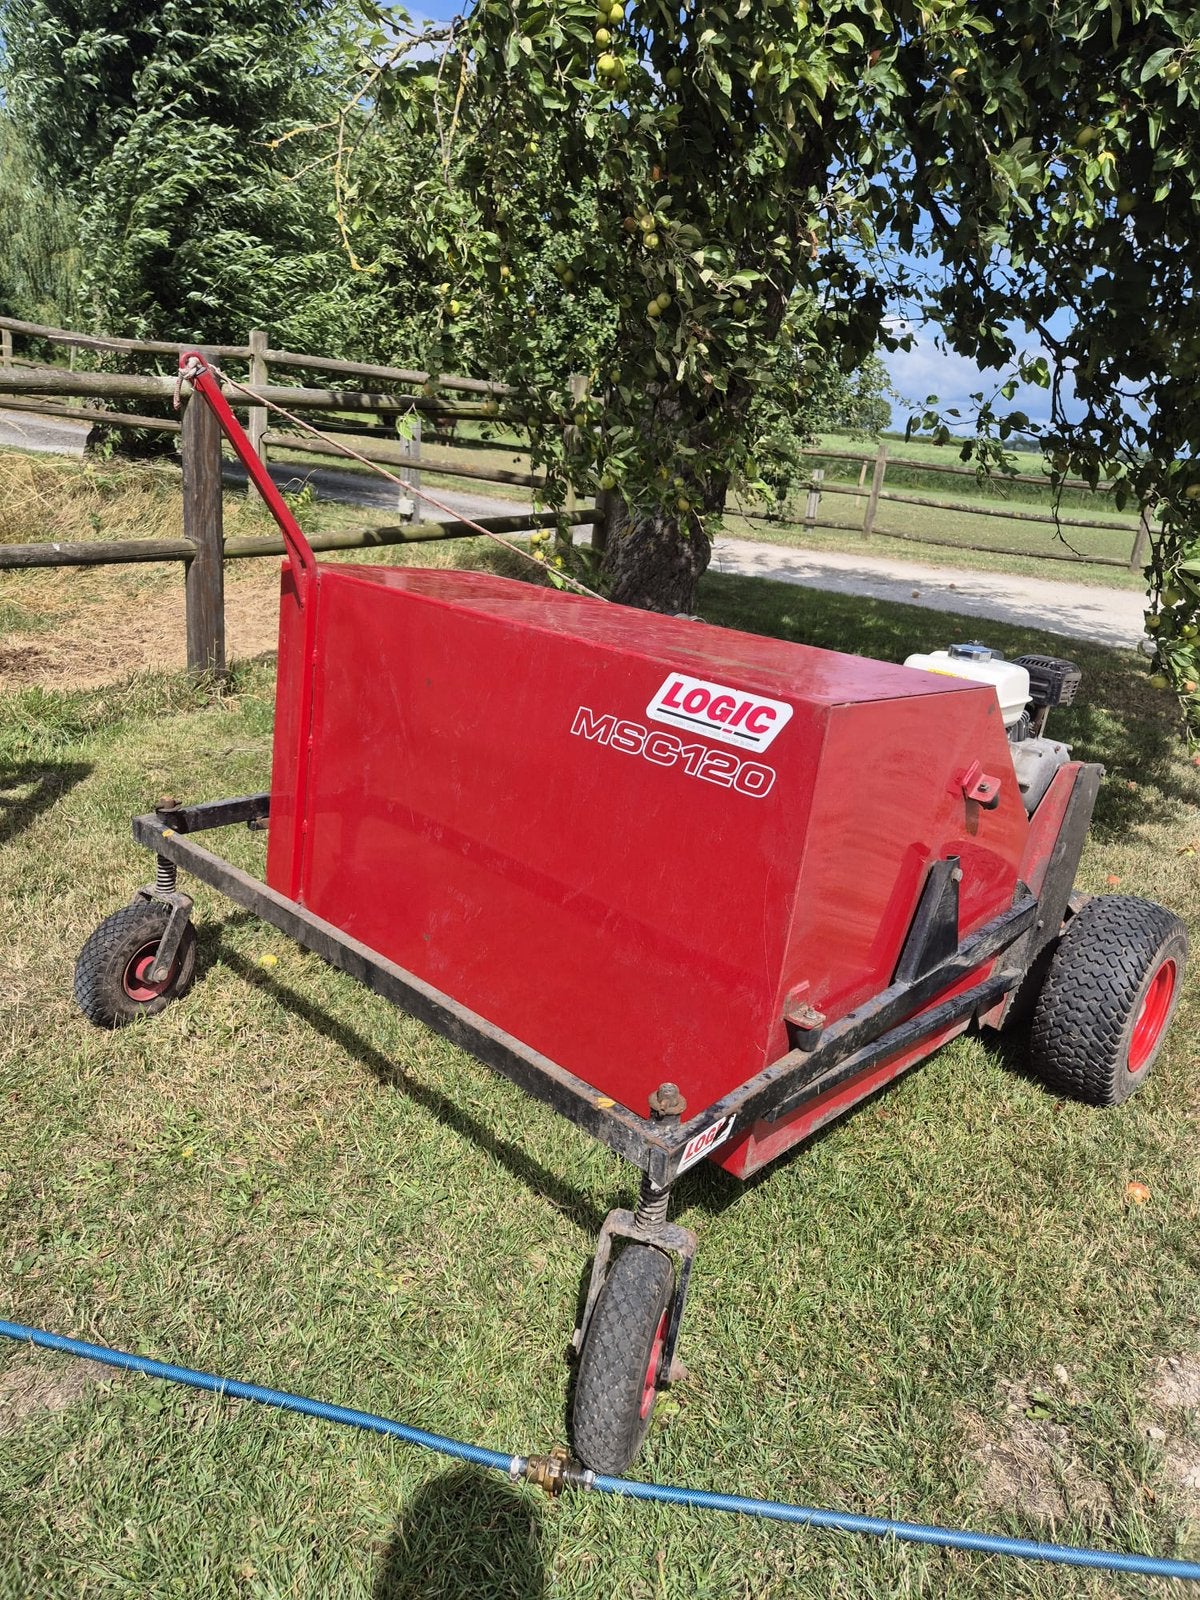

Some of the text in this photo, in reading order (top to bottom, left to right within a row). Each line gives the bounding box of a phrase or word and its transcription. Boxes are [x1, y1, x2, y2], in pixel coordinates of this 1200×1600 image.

[661, 681, 777, 734] LOGIC
[570, 706, 776, 798] MSC120
[684, 1122, 723, 1160] LOG
